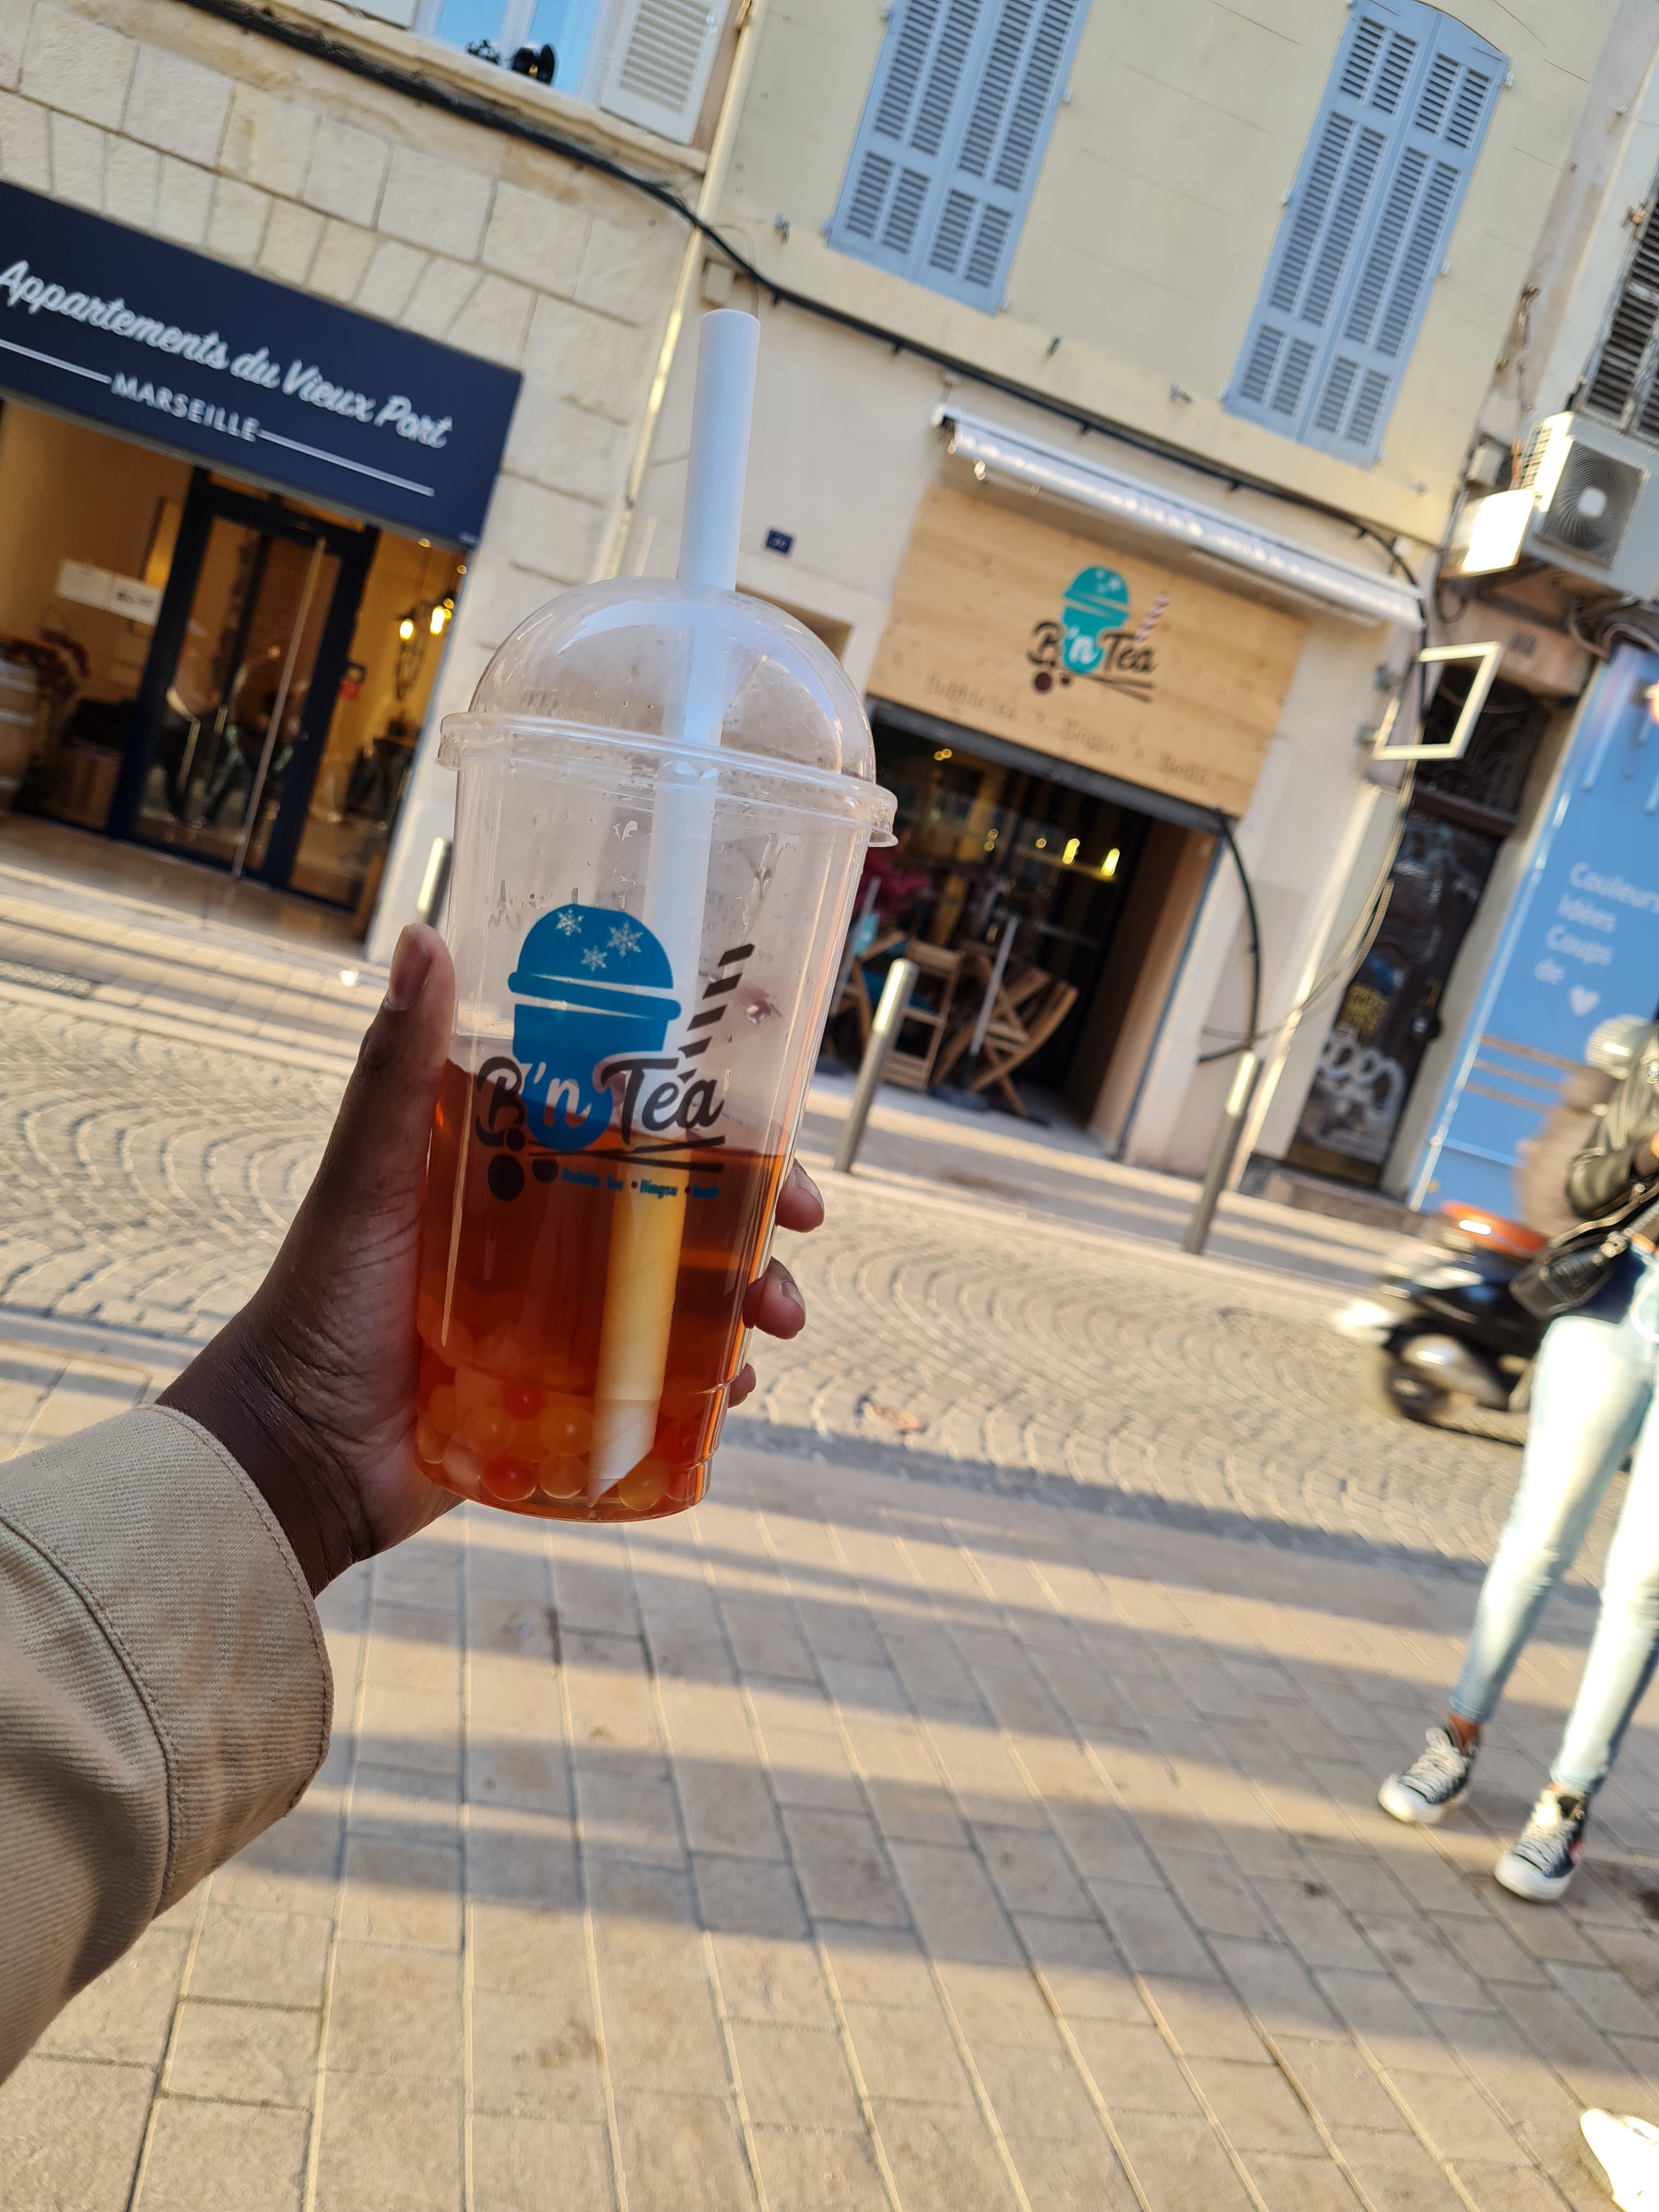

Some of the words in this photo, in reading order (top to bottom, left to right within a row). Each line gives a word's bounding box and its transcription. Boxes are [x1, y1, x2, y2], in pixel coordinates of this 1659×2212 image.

[0, 259, 229, 370] Appartements
[230, 346, 281, 389] du
[282, 358, 376, 422] Vieux
[374, 394, 453, 449] Port
[111, 371, 260, 443] MARSEILLE
